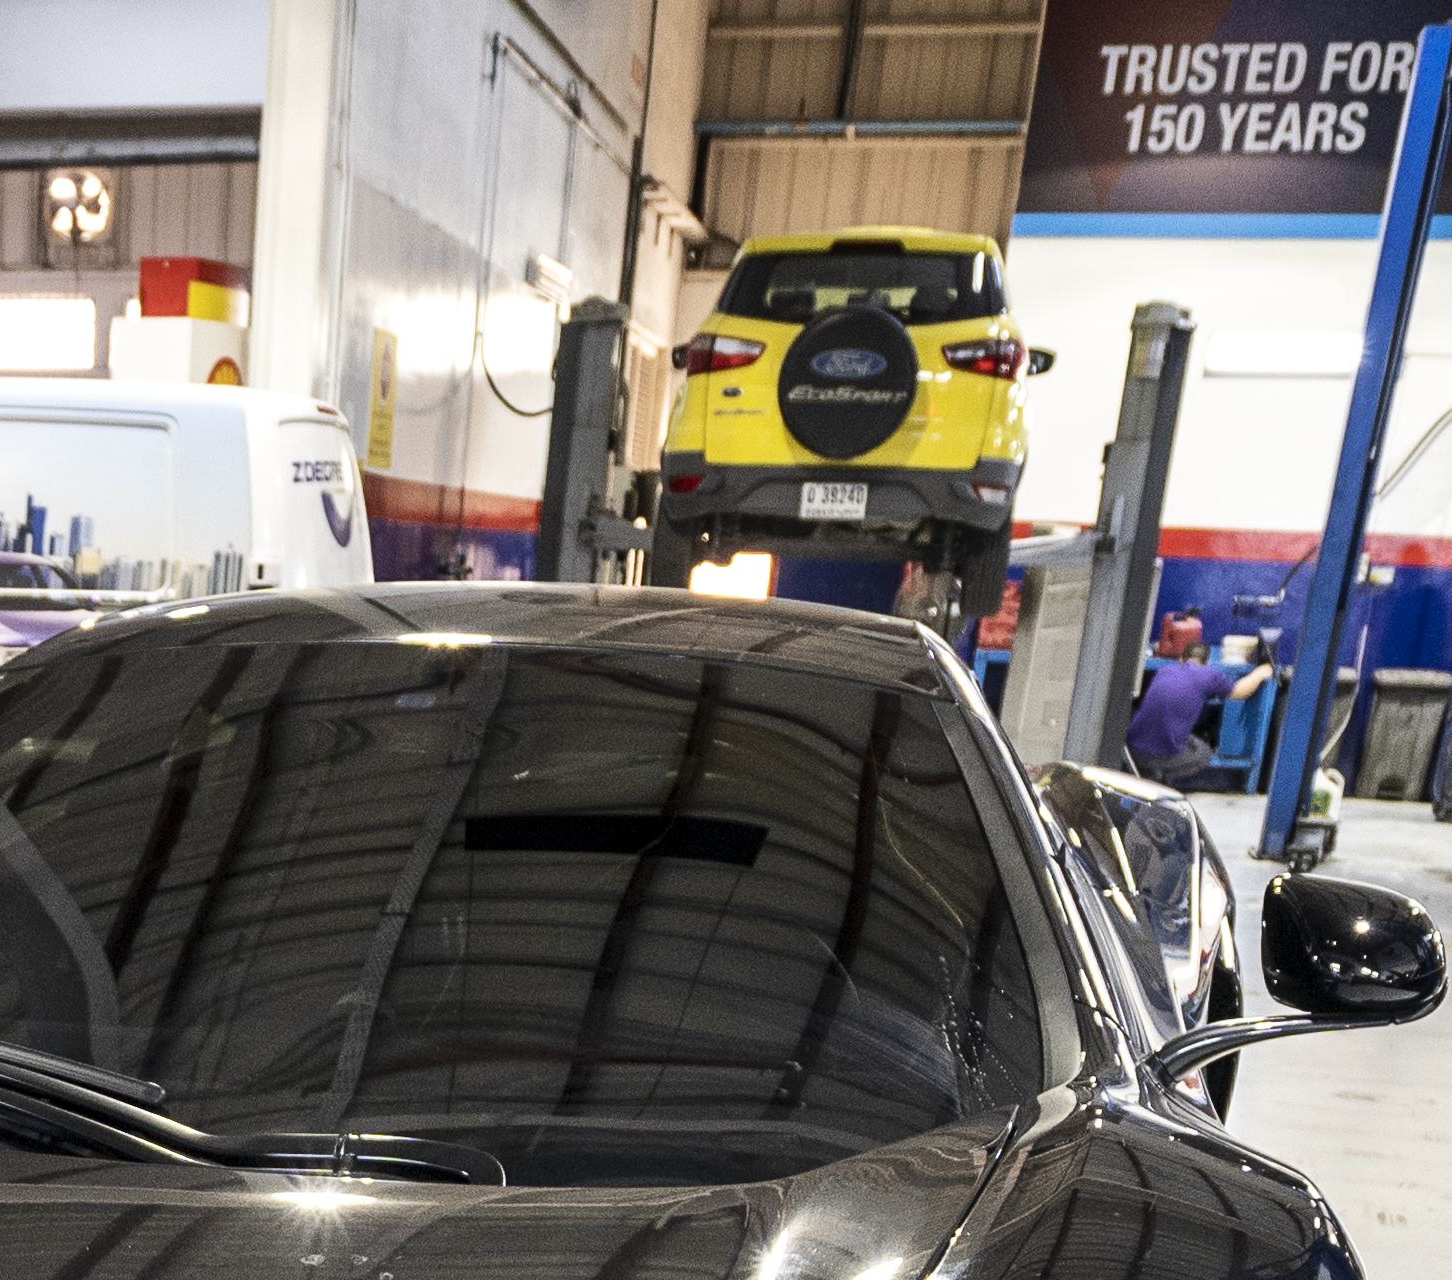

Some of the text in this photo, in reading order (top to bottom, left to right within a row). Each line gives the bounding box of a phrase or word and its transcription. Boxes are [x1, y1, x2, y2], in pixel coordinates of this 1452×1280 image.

[1100, 41, 1416, 95] TRUSTED FOR
[1124, 100, 1370, 154] 150 YEARS
[824, 351, 871, 377] Ford
